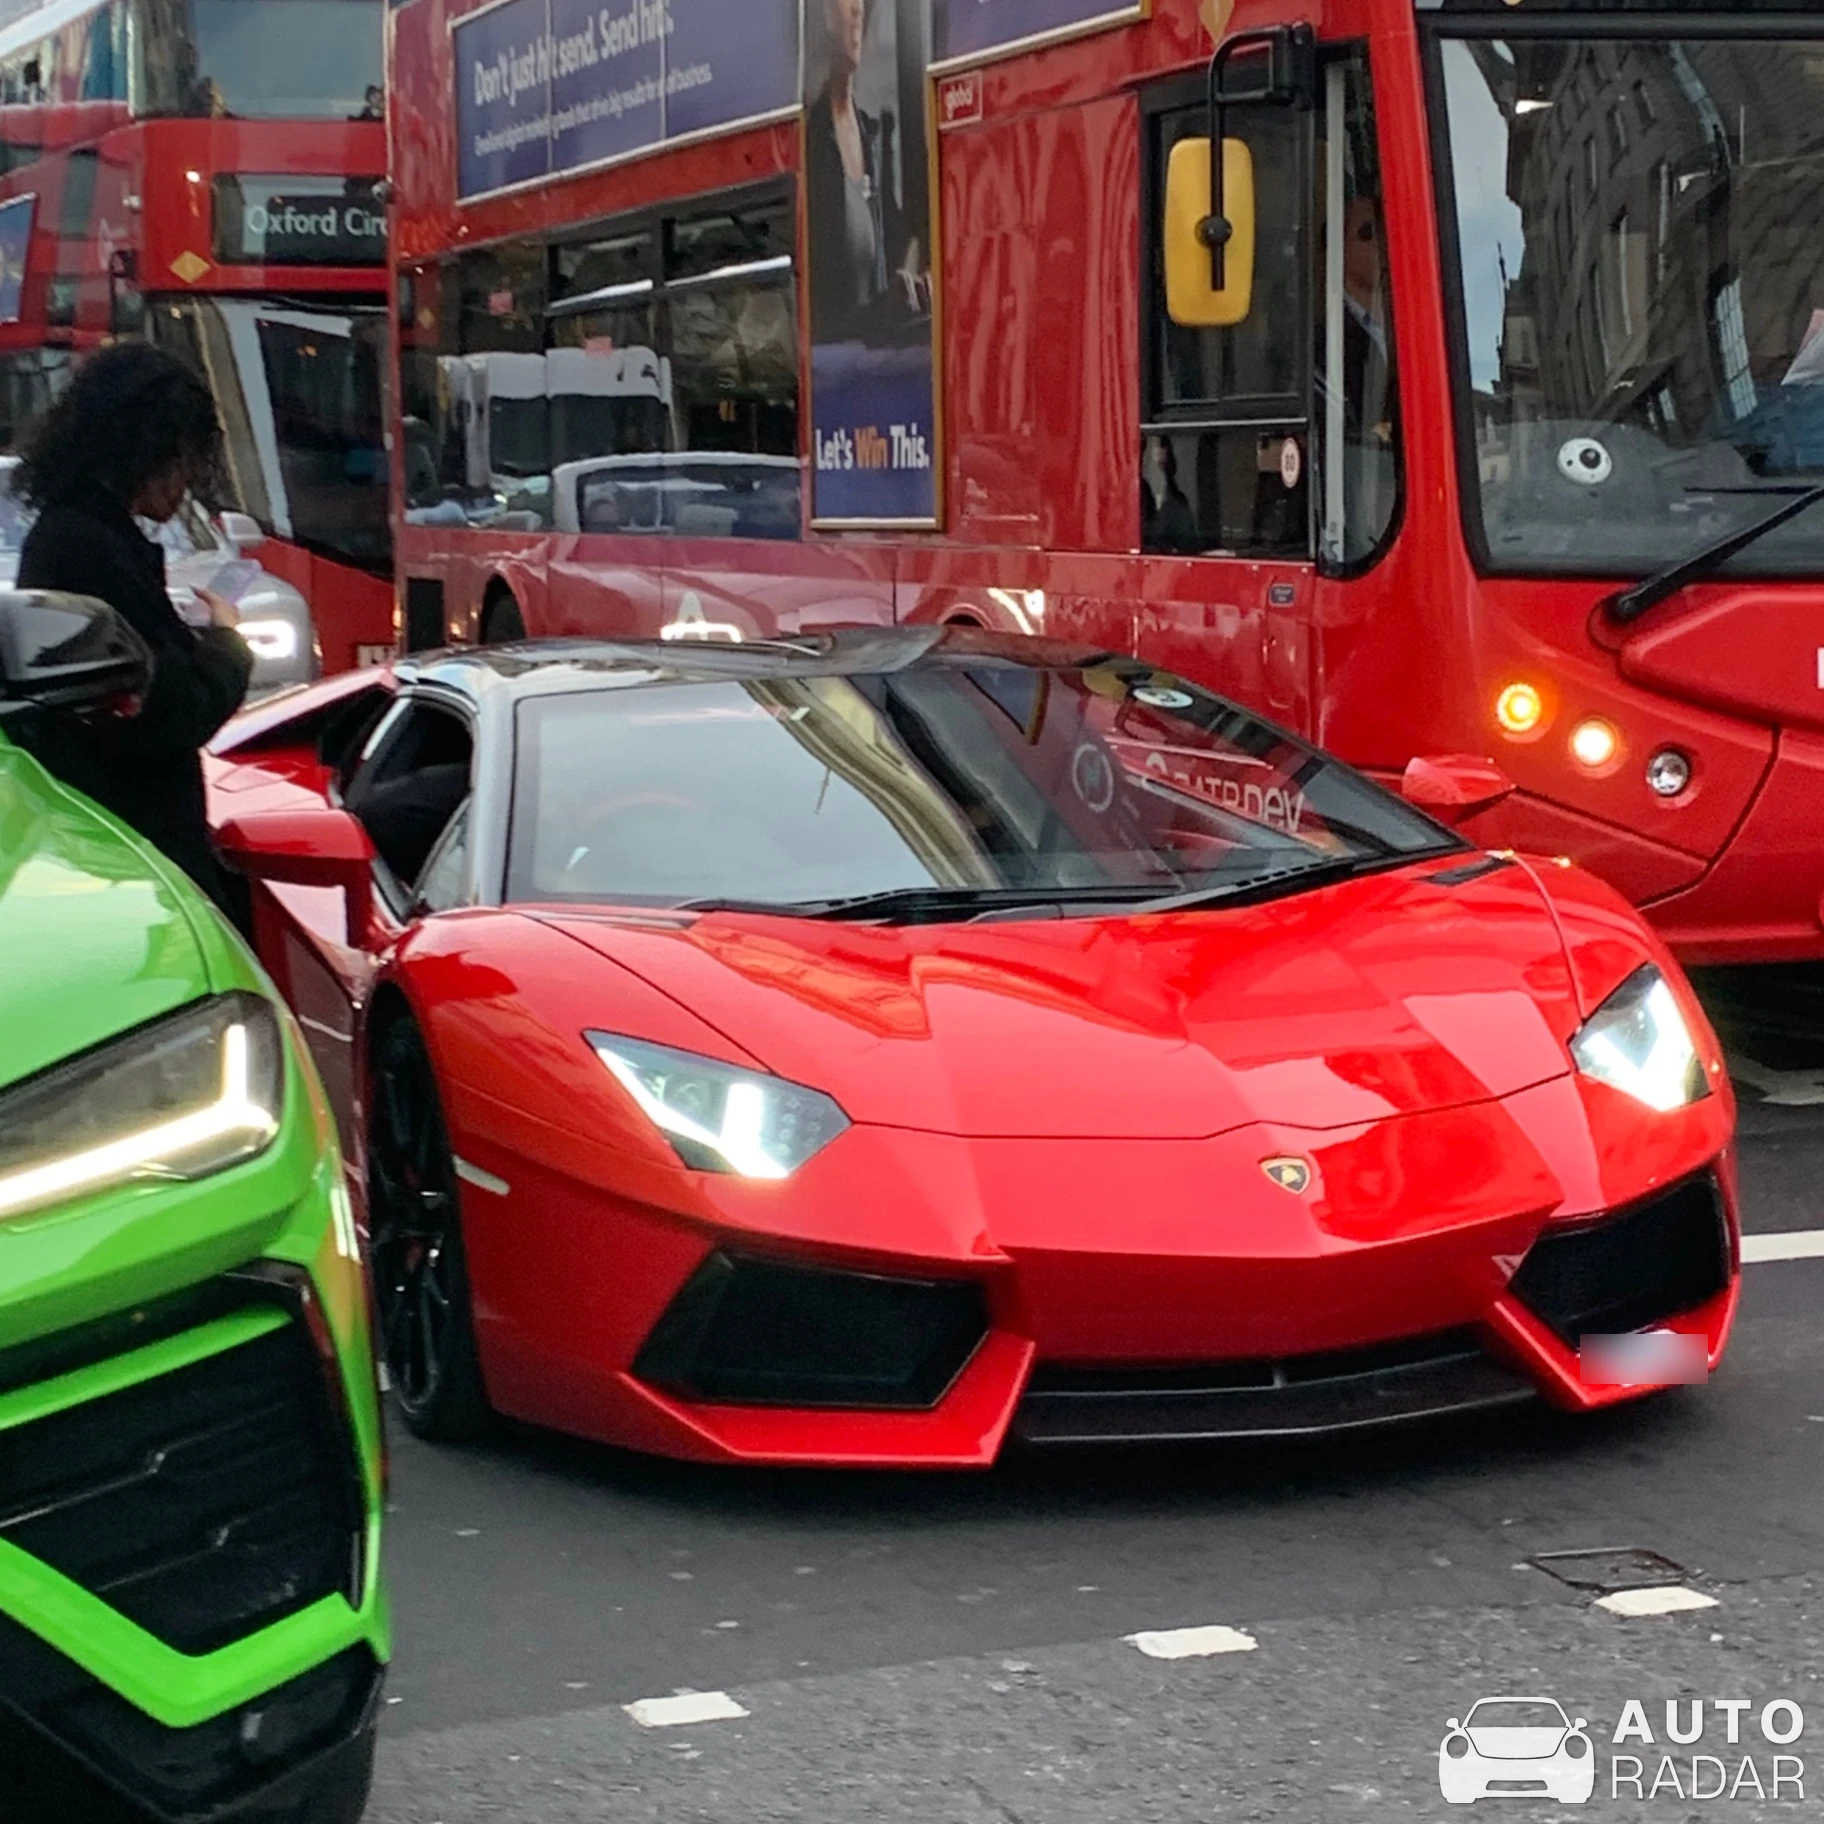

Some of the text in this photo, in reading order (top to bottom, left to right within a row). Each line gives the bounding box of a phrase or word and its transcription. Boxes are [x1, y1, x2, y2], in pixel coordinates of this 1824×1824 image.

[474, 53, 509, 106] Don't
[509, 45, 536, 108] just
[560, 15, 599, 77] send.
[600, 0, 638, 60] Send
[248, 205, 338, 237] Oxford
[815, 422, 930, 470] Let's Win This.
